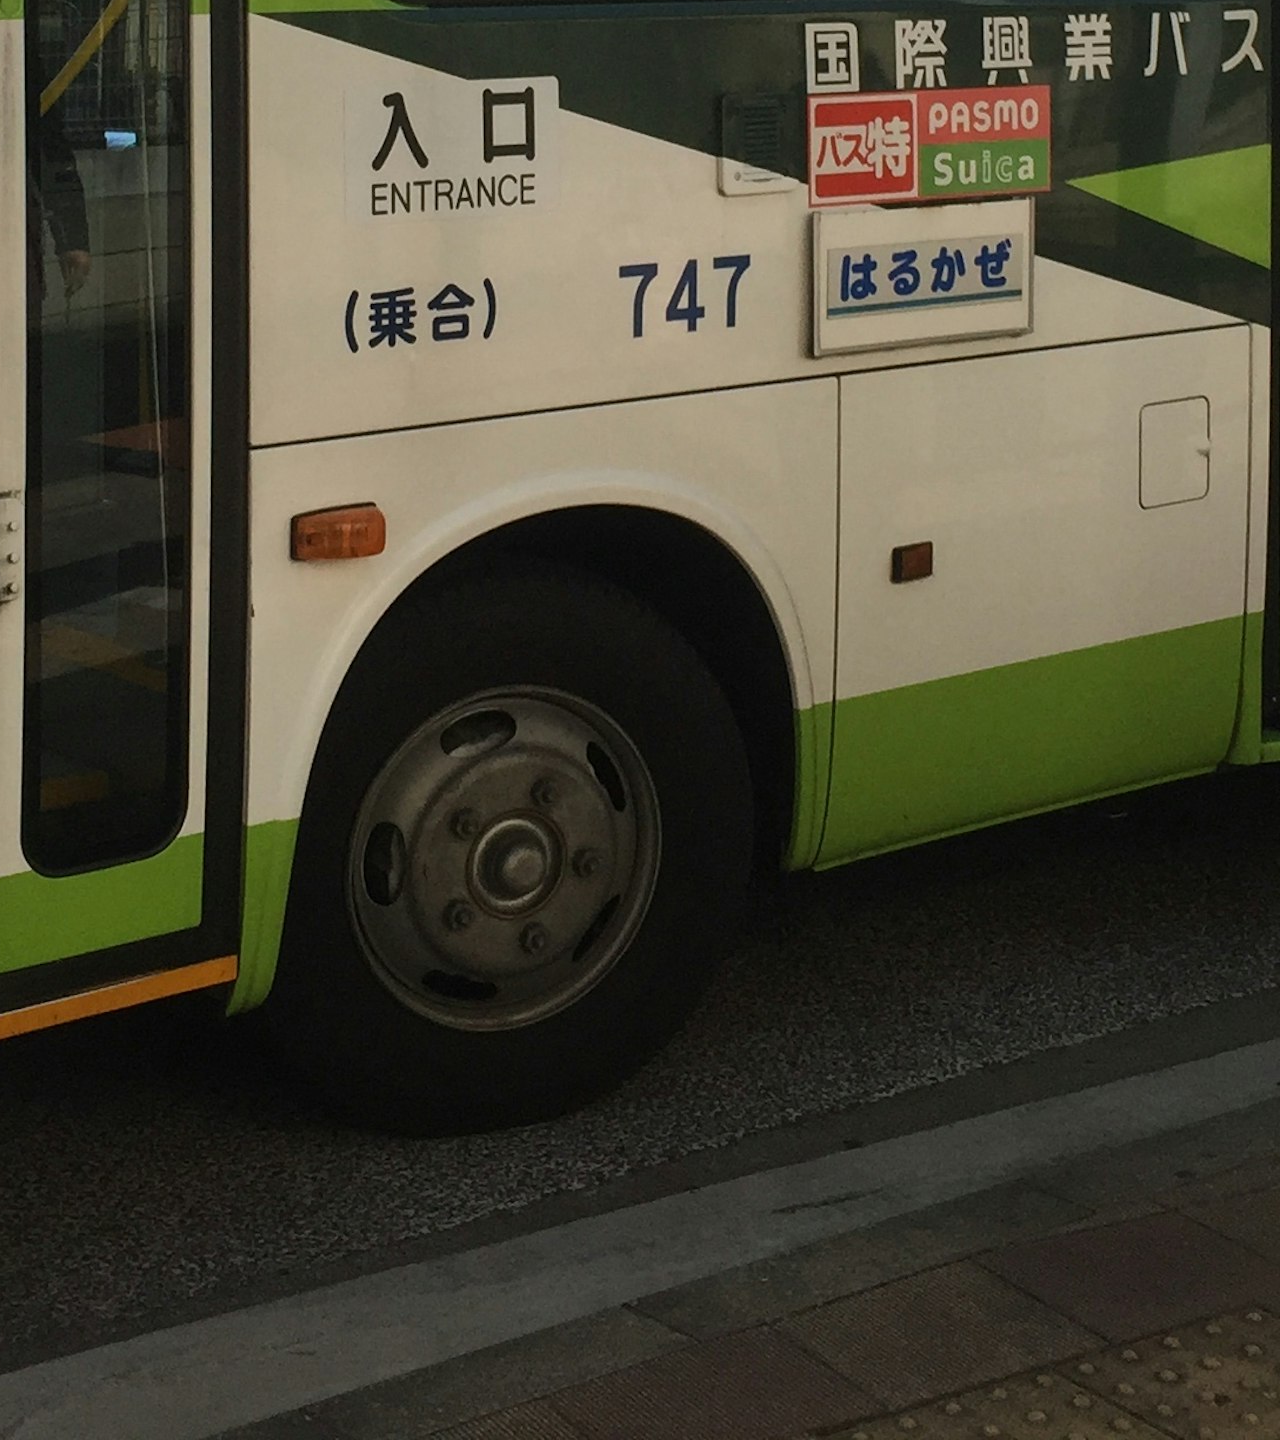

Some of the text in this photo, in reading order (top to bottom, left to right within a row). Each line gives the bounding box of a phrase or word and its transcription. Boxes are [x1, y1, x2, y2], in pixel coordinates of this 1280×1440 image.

[804, 8, 1265, 95] 国際興業バス
[371, 85, 536, 172] 入口
[816, 114, 912, 180] バス特
[927, 97, 1040, 137] PASMO
[371, 173, 537, 216] ENTRANCE
[932, 149, 1036, 188] Suica
[617, 253, 752, 339] 747
[839, 237, 1013, 303] はるかぜ
[344, 276, 497, 354] (乗合)
